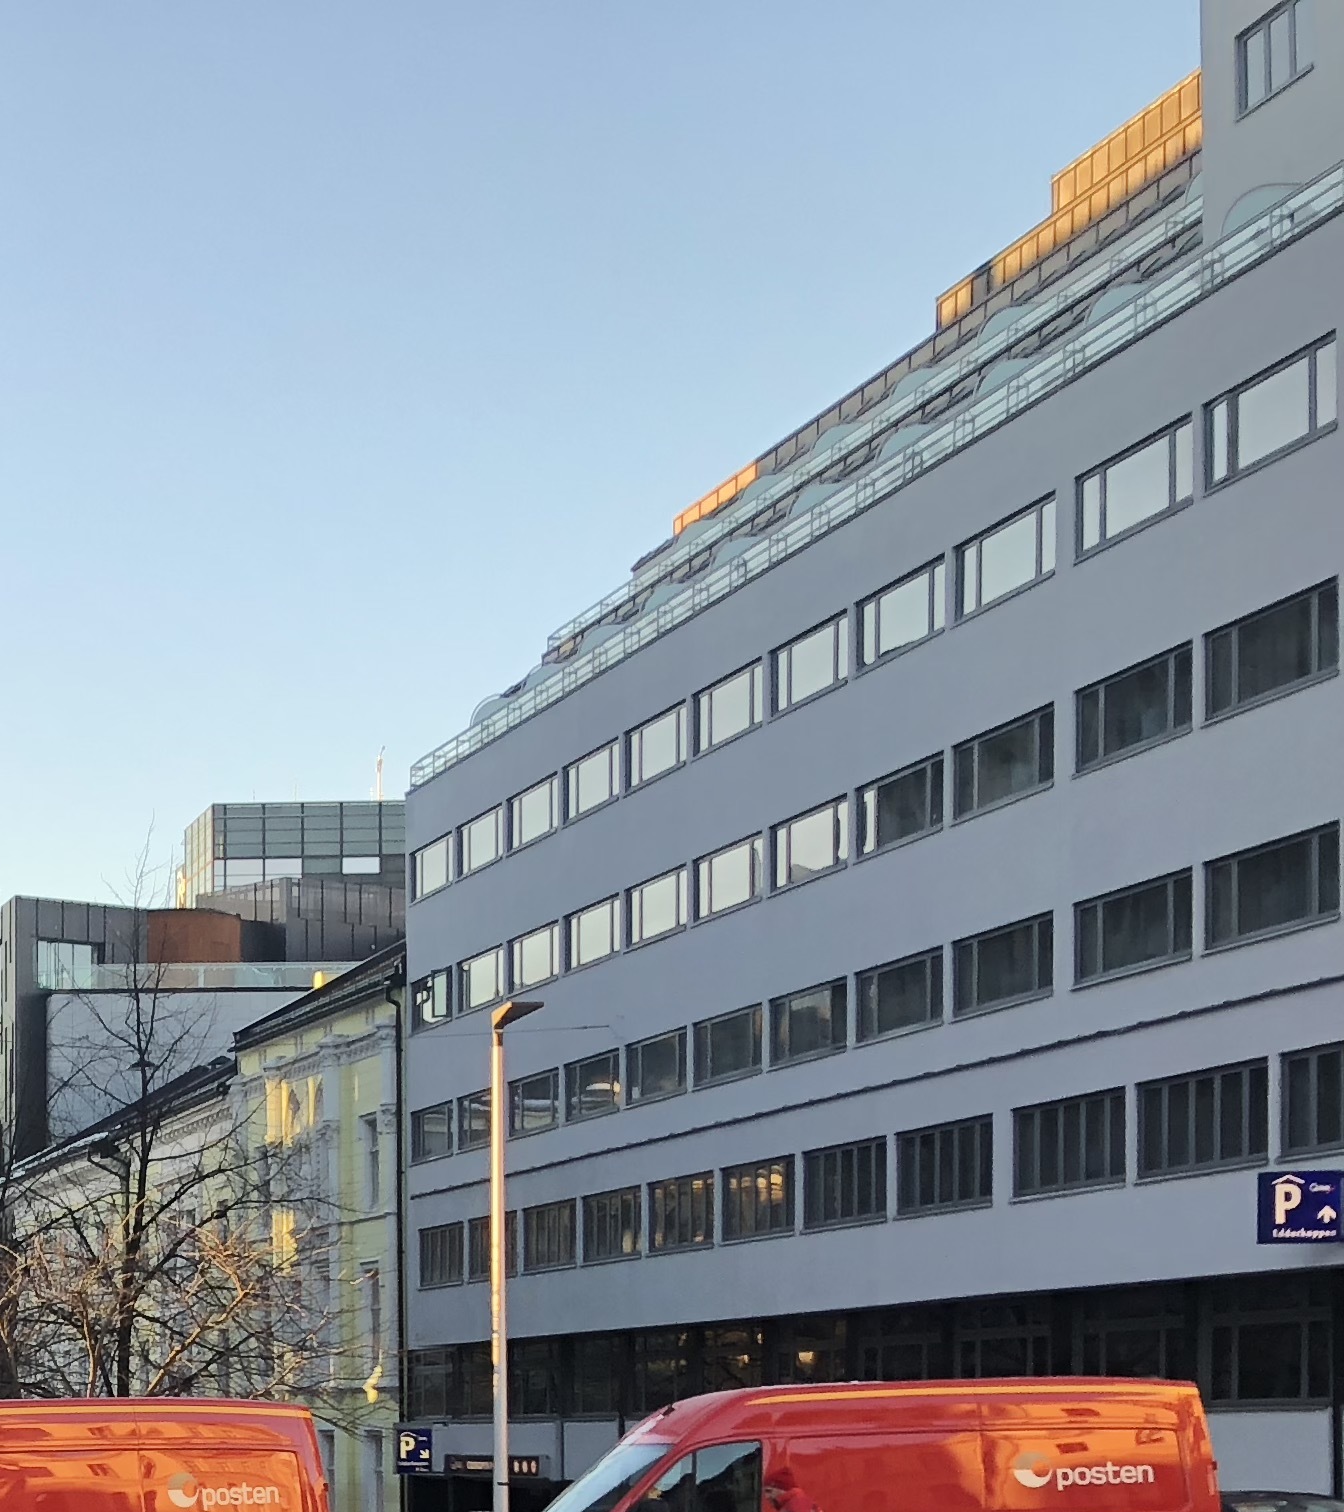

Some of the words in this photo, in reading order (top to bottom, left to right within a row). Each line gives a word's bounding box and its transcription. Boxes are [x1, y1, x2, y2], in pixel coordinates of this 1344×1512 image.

[1275, 1183, 1302, 1225] P
[399, 1436, 416, 1459] P
[1055, 1461, 1155, 1491] posten
[201, 1481, 280, 1511] posten
